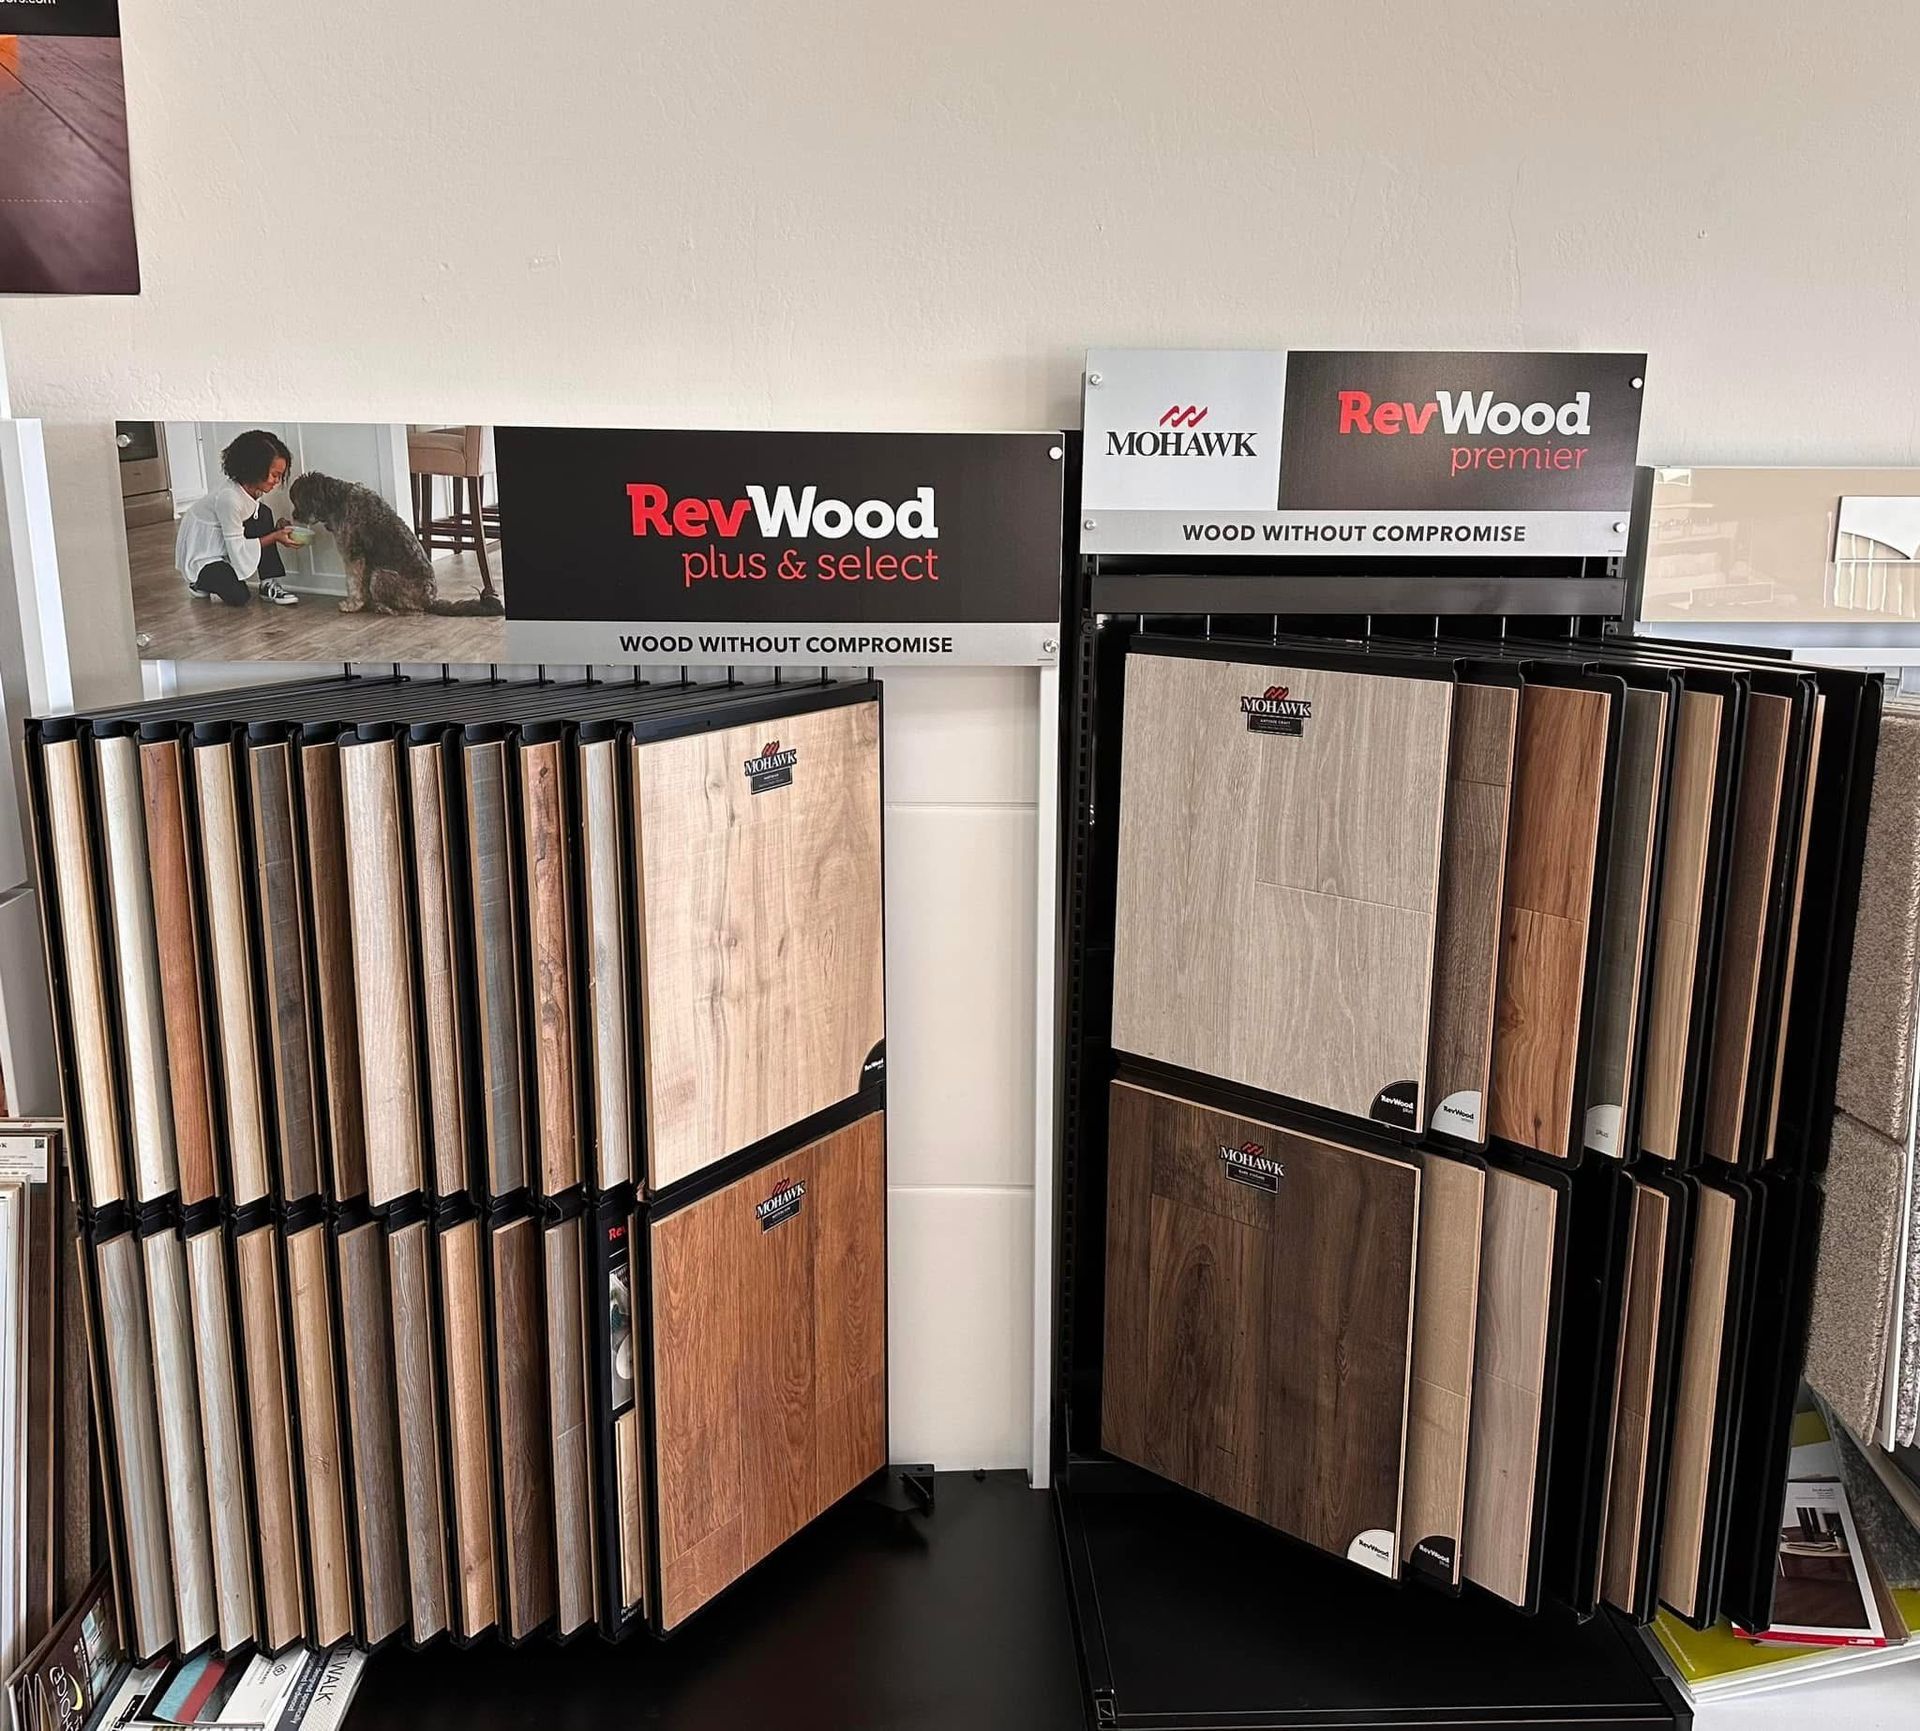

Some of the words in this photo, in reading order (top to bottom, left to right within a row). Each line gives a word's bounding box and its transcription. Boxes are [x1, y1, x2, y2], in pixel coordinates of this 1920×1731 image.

[1338, 390, 1591, 436] RevWood
[1105, 431, 1258, 458] MOHAWK
[1450, 440, 1589, 477] premier
[626, 482, 940, 540] RevWood
[1182, 523, 1256, 543] WOOD
[1261, 523, 1368, 543] WITHOUT
[1372, 524, 1526, 543] COMPROMISE
[682, 545, 767, 588] plus
[777, 548, 808, 581] &
[817, 545, 940, 582] select
[619, 635, 694, 654] WOOD
[698, 635, 802, 655] WITHOUT
[806, 636, 953, 654] COMPROMISE
[1243, 698, 1309, 716] MOHAWK
[745, 751, 796, 775] MOHAWK
[1381, 1095, 1414, 1109] RevWood
[1443, 1105, 1474, 1119] RevWood
[1220, 1146, 1285, 1177] MOHAWK
[757, 1182, 805, 1218] MOHAWK
[314, 1661, 346, 1703] WALK
